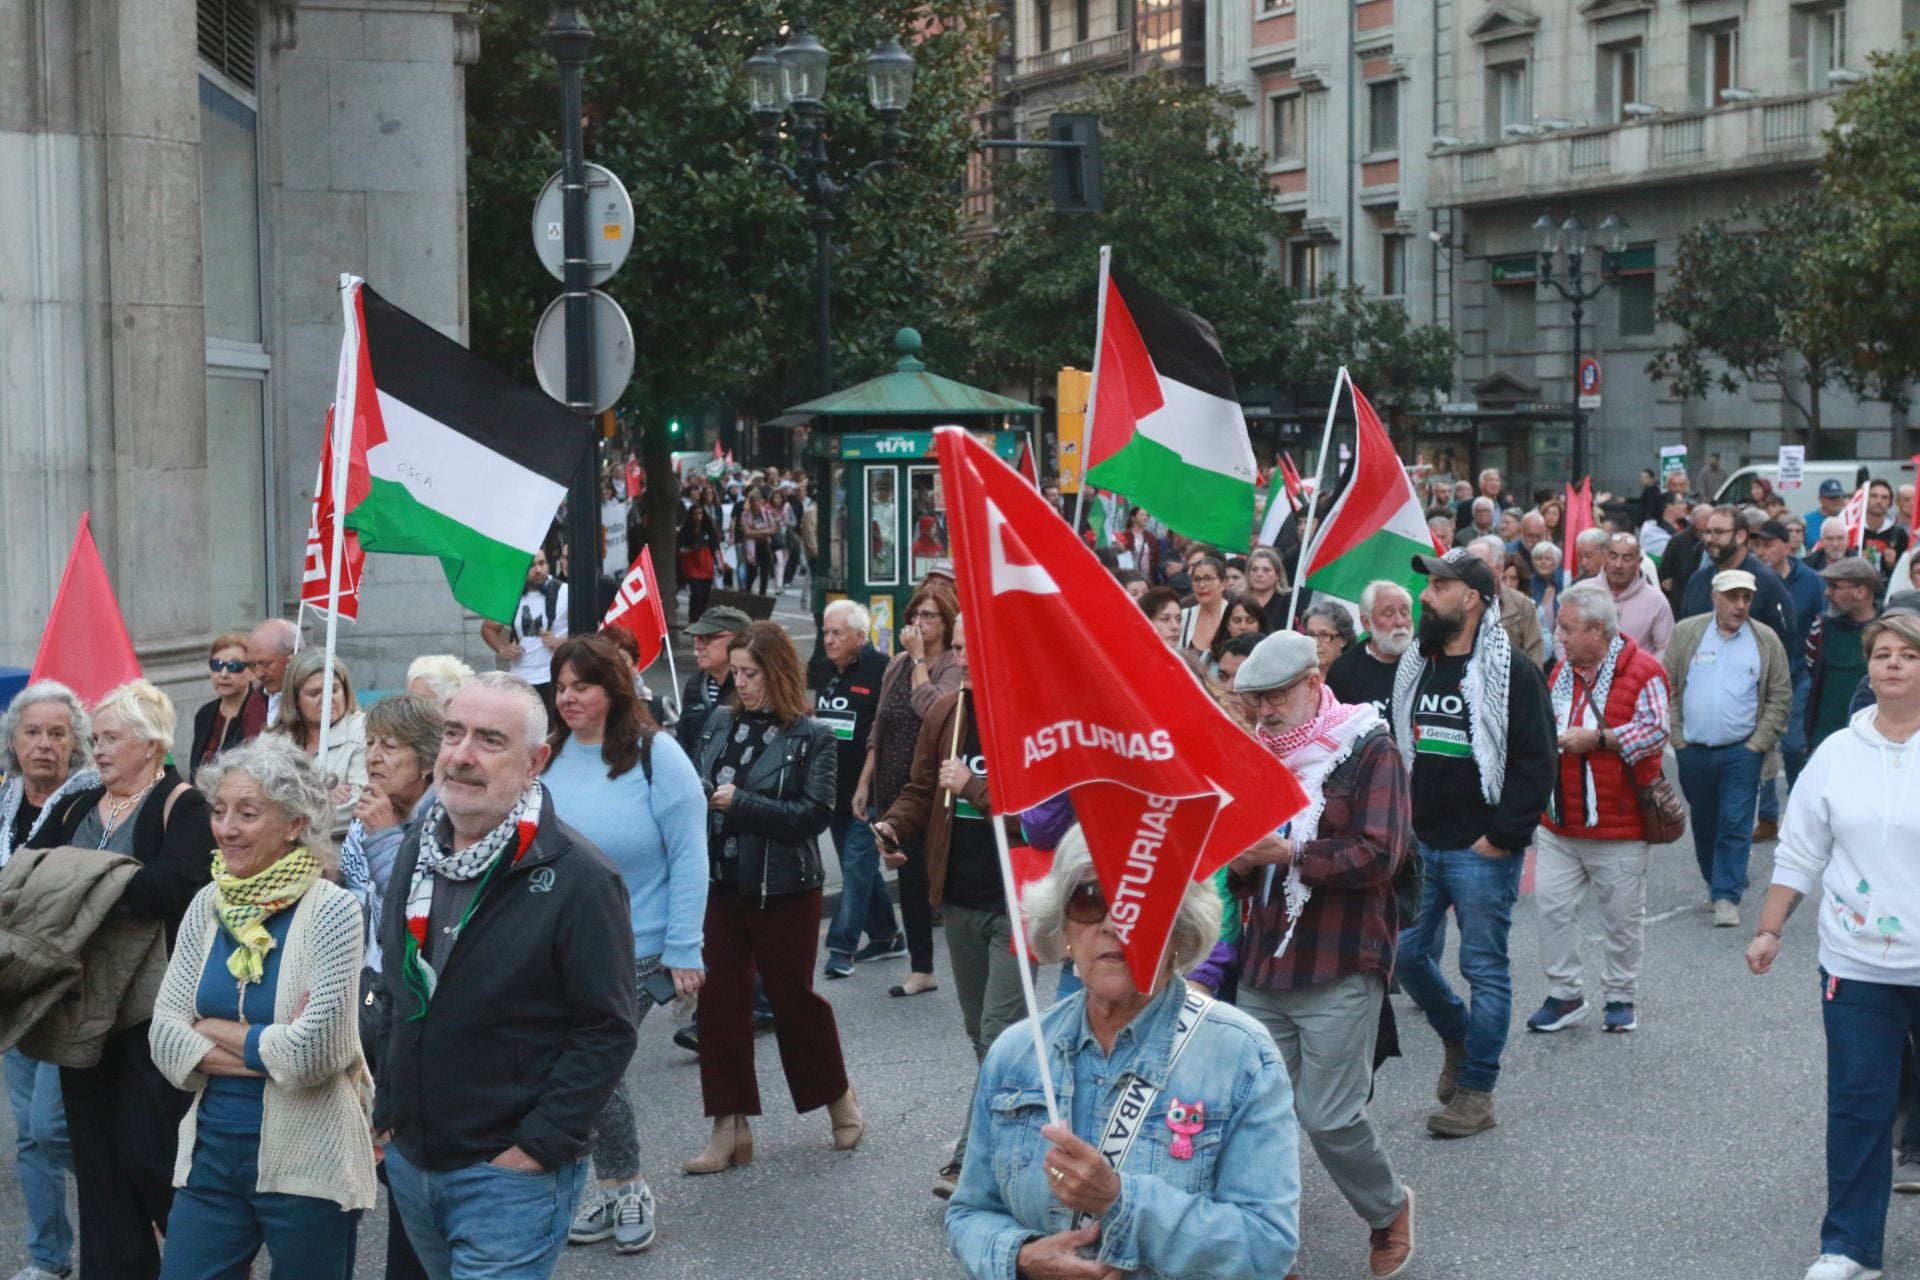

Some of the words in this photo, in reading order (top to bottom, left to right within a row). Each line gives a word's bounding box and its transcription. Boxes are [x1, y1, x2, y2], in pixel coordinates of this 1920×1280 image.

[818, 696, 849, 711] NO
[1420, 694, 1463, 715] NO
[1023, 720, 1175, 769] ASTURIAS
[1110, 793, 1178, 945] ASTURIAS
